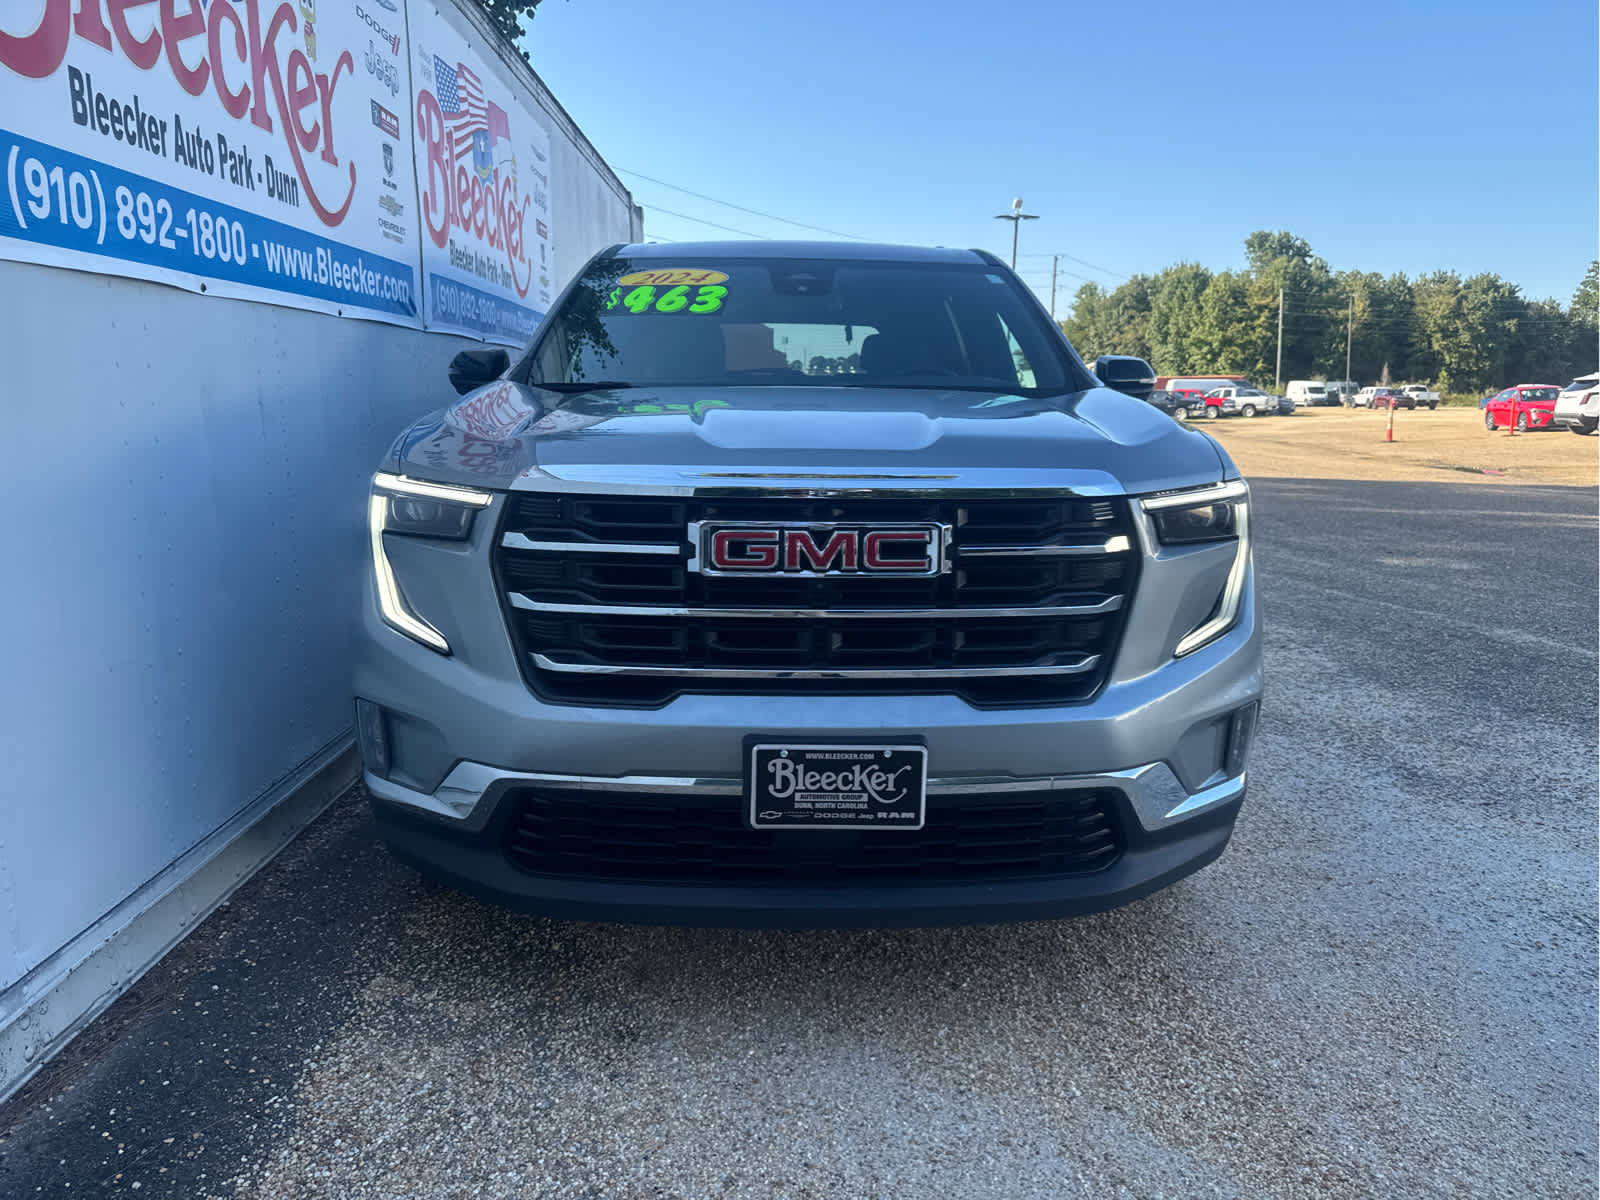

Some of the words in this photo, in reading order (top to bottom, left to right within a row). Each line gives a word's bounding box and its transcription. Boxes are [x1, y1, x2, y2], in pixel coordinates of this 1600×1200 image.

[356, 5, 394, 46] DODGE
[364, 39, 399, 97] Jeep
[67, 64, 167, 157] Bleecker
[174, 113, 214, 176] Auto
[216, 132, 255, 191] Park
[264, 153, 299, 208] Dunn
[416, 88, 531, 298] Bleecker
[7, 145, 106, 245] (910)
[115, 185, 247, 266] 892-1800
[262, 240, 410, 305] www.Bleecker.com
[631, 272, 713, 285] 2024
[606, 285, 728, 314] $463
[712, 530, 932, 569] GMC
[805, 752, 875, 760] WWW.BLEECKER.COM
[767, 758, 912, 803] Bleecker
[857, 812, 875, 820] Jeep
